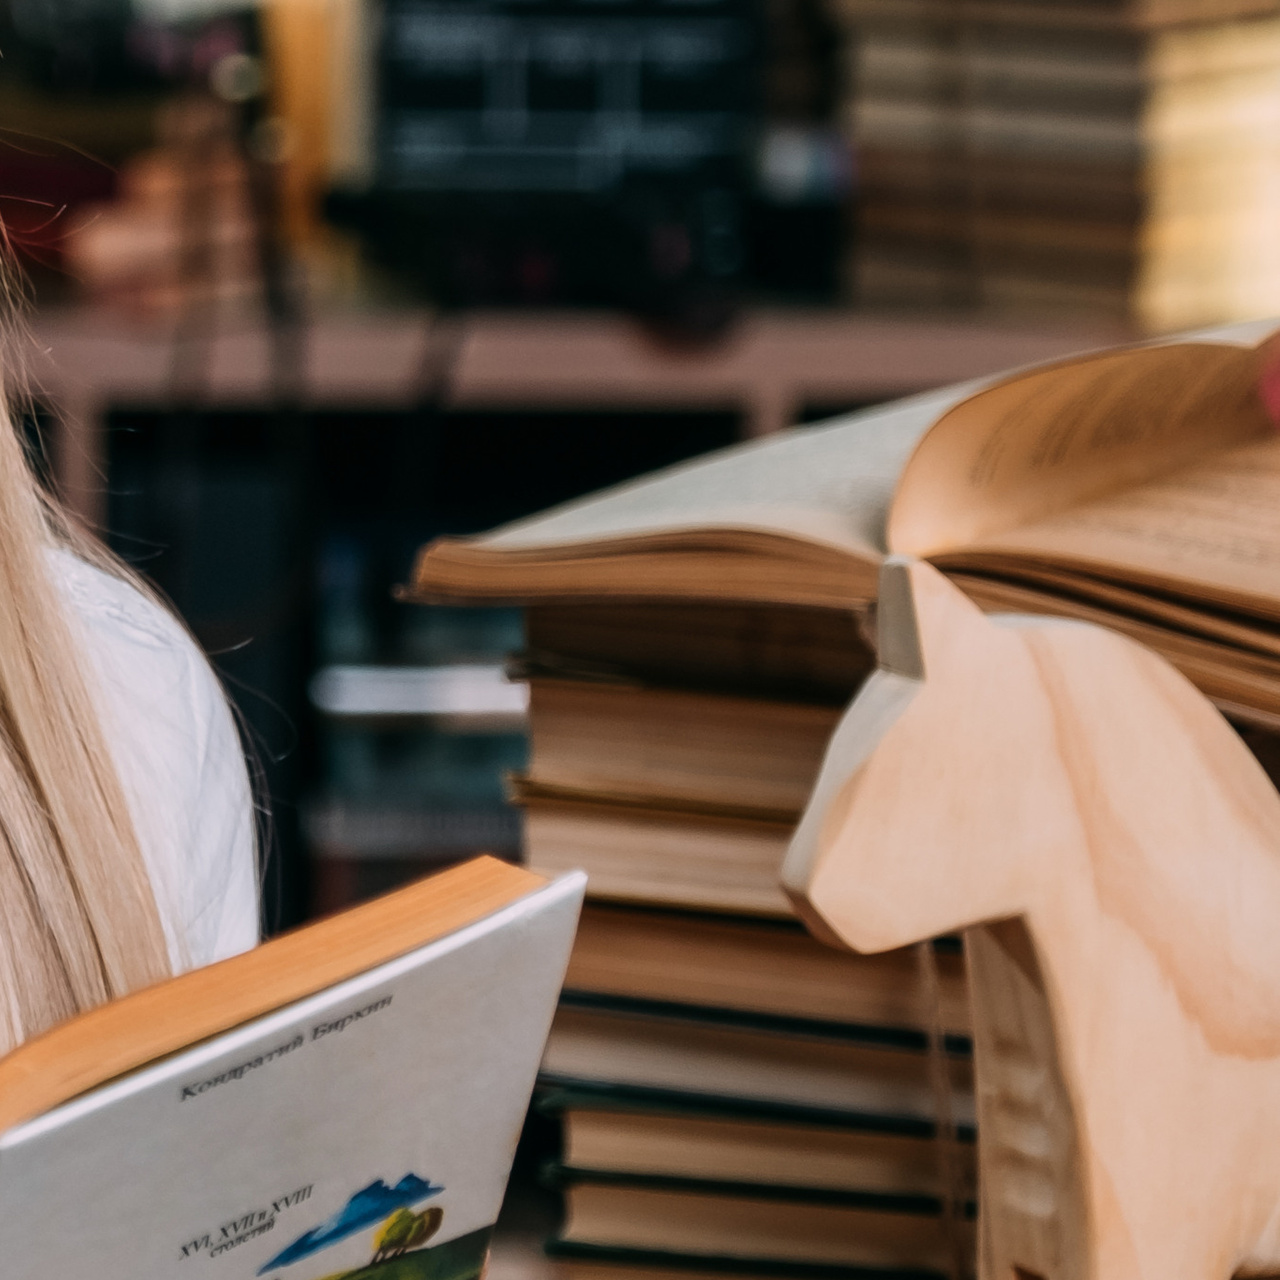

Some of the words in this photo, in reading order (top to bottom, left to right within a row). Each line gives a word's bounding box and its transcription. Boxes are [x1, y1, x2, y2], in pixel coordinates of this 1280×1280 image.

[180, 1034, 305, 1103] Кондратий
[311, 994, 394, 1042] Биркин
[210, 1216, 275, 1258] столетий
[219, 1212, 256, 1242] XVII
[269, 1184, 316, 1218] XVIII
